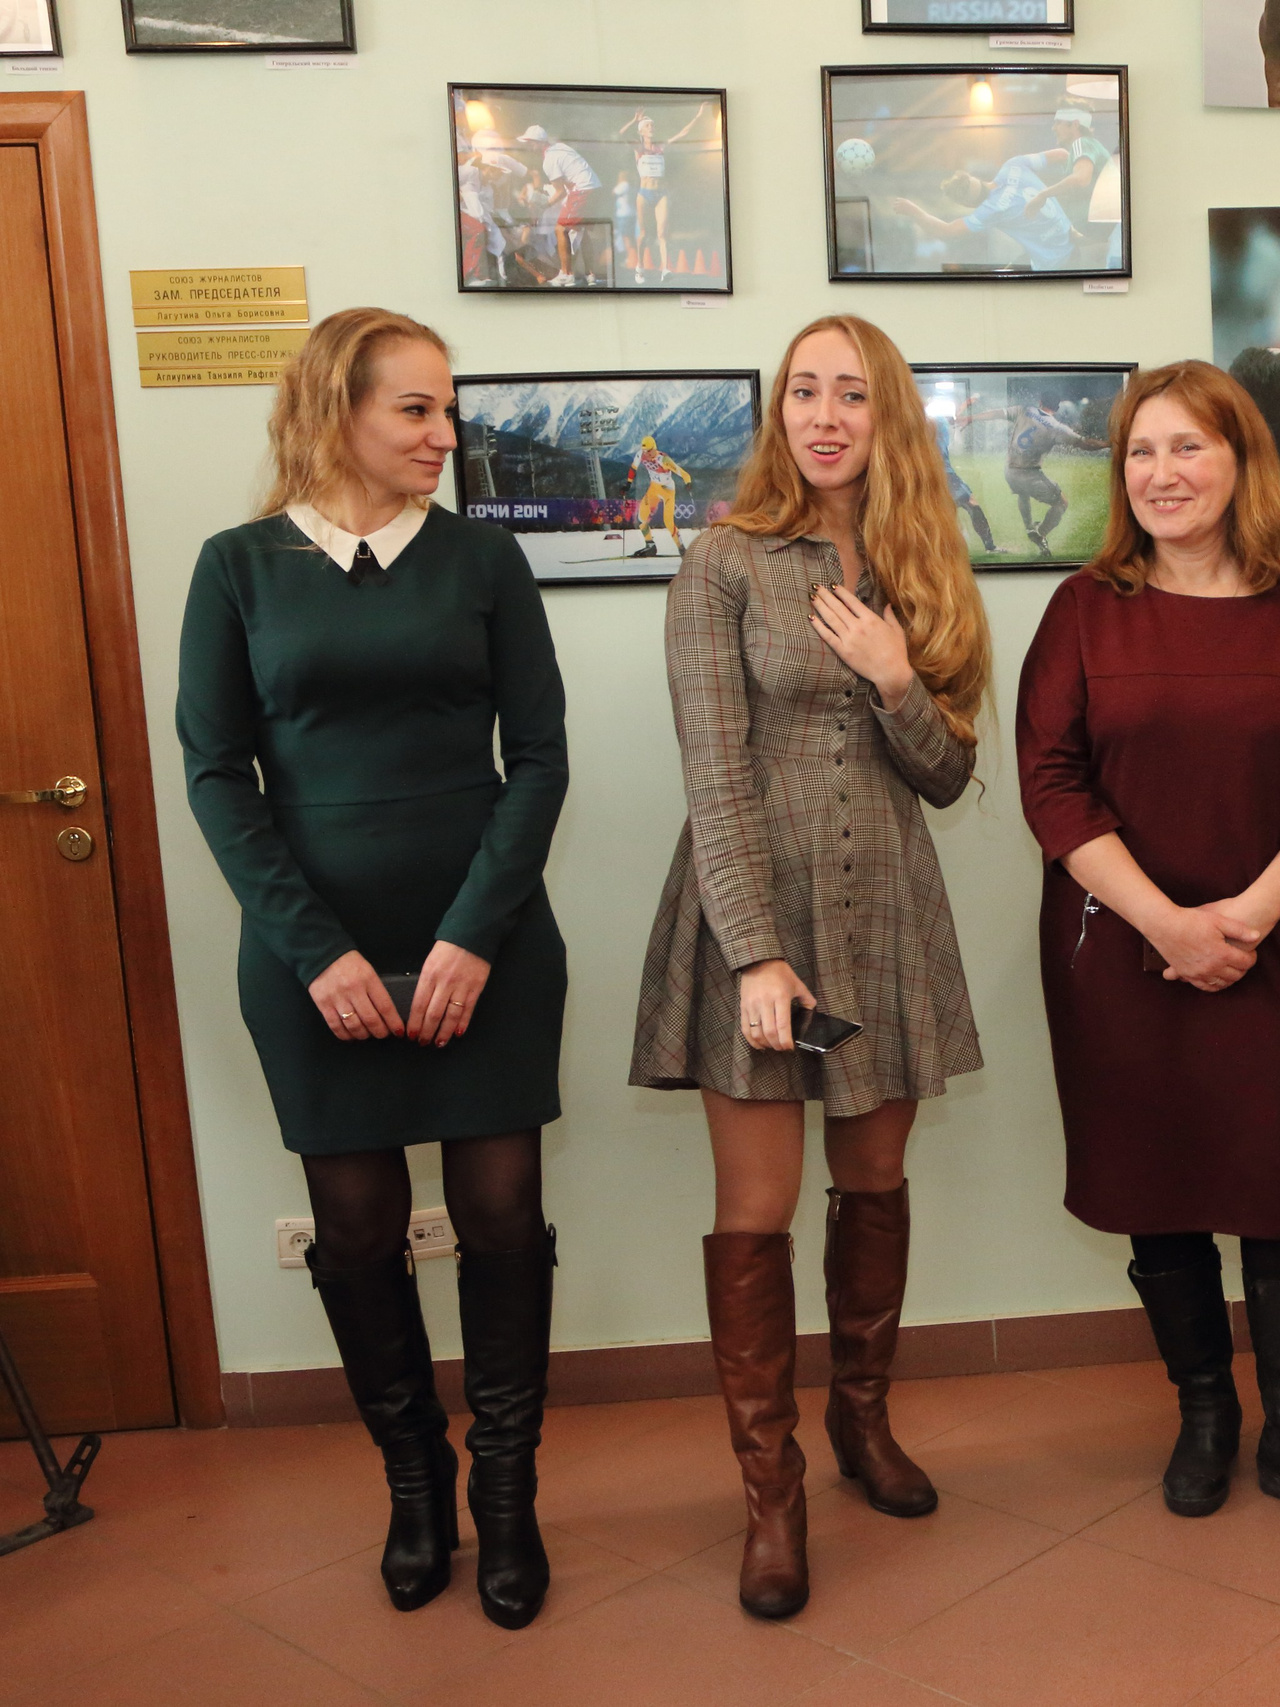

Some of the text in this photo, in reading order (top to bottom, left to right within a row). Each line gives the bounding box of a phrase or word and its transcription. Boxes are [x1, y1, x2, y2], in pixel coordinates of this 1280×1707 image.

[927, 2, 1003, 20] RUSSIA
[169, 274, 262, 284] СОЮЗ ЖУРНАЛИСТОВ
[154, 287, 281, 300] ЗАМ. ПРЕДСЕДАТЕЛЯ
[157, 310, 285, 321] Лагутина Ольга Борисовна
[177, 335, 271, 344] СОЮЗ ЖУРНАЛИСТОВ
[149, 352, 223, 361] РУКОВОДИТЕЛЬ
[207, 371, 243, 380] Танзиля
[247, 370, 281, 380] Рафгат
[1017, 426, 1037, 449] 6
[467, 504, 548, 518] СОЧИ 2014
